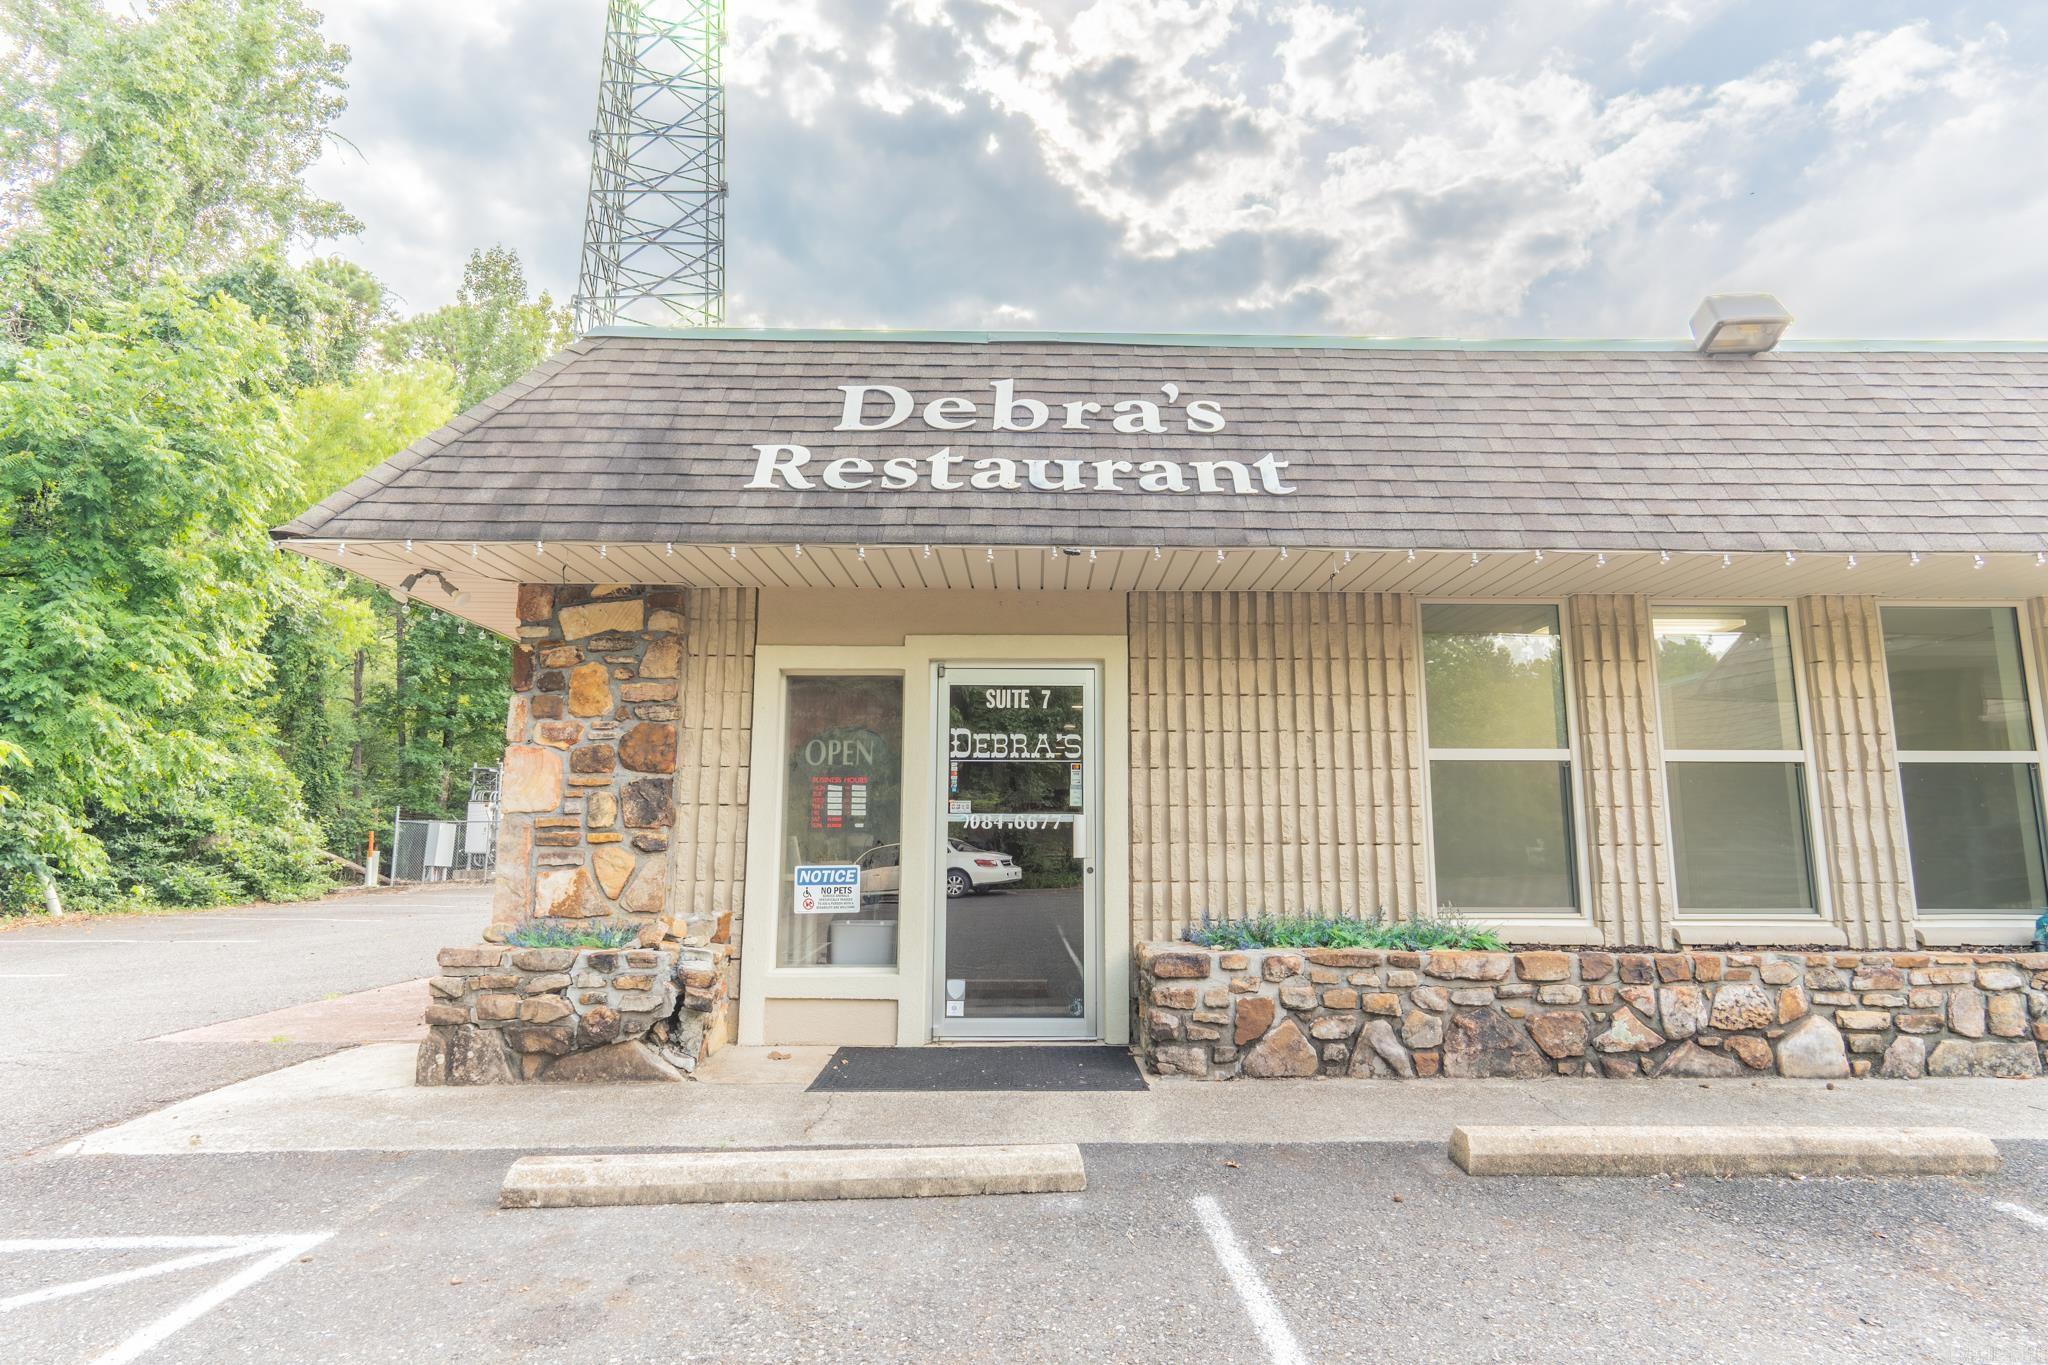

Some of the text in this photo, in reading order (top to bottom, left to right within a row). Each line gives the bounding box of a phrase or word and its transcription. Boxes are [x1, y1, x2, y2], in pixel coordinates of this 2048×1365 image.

[832, 378, 1226, 434] Debra's
[743, 443, 1298, 495] Restaurant
[986, 689, 1051, 709] SUITE 7
[805, 739, 874, 767] OPEN
[950, 728, 1082, 759] DEBRA'S
[799, 869, 857, 883] NOTICE
[821, 886, 853, 895] NO PETS
